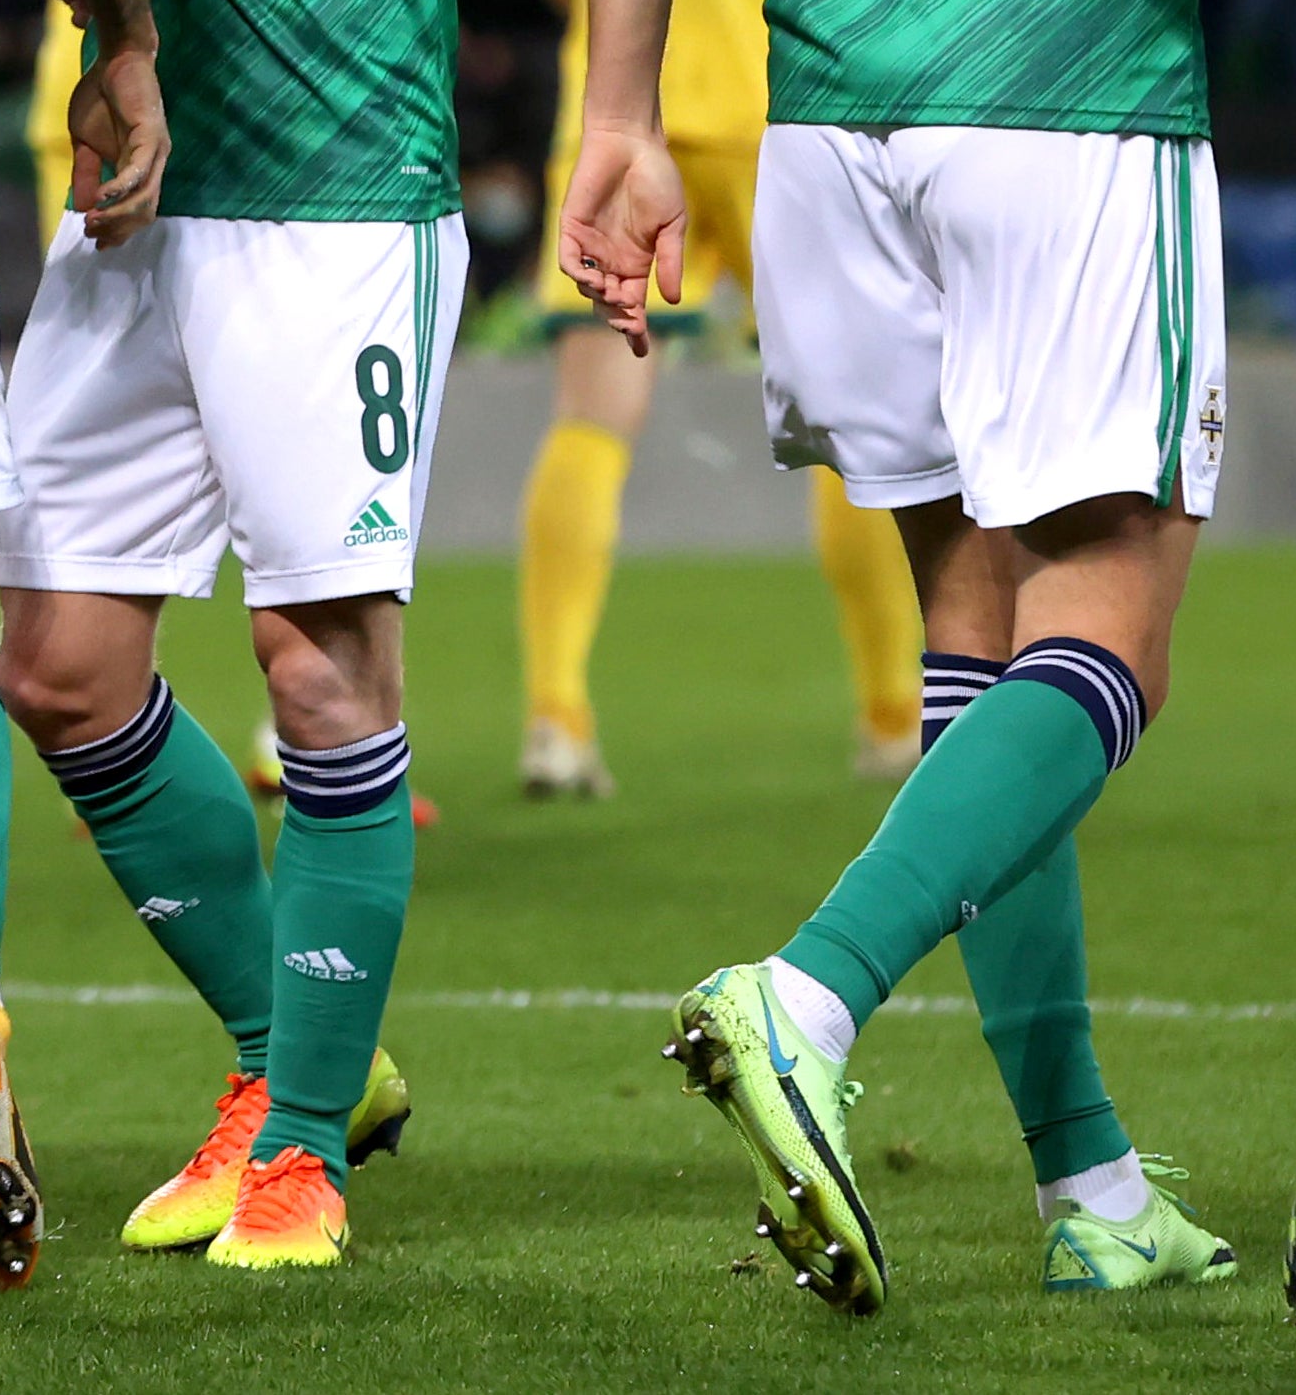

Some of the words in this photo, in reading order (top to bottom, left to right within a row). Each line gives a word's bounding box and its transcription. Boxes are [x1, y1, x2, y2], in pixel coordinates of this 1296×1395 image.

[355, 344, 409, 475] 8
[343, 526, 408, 547] adidas
[284, 955, 368, 982] adidas
